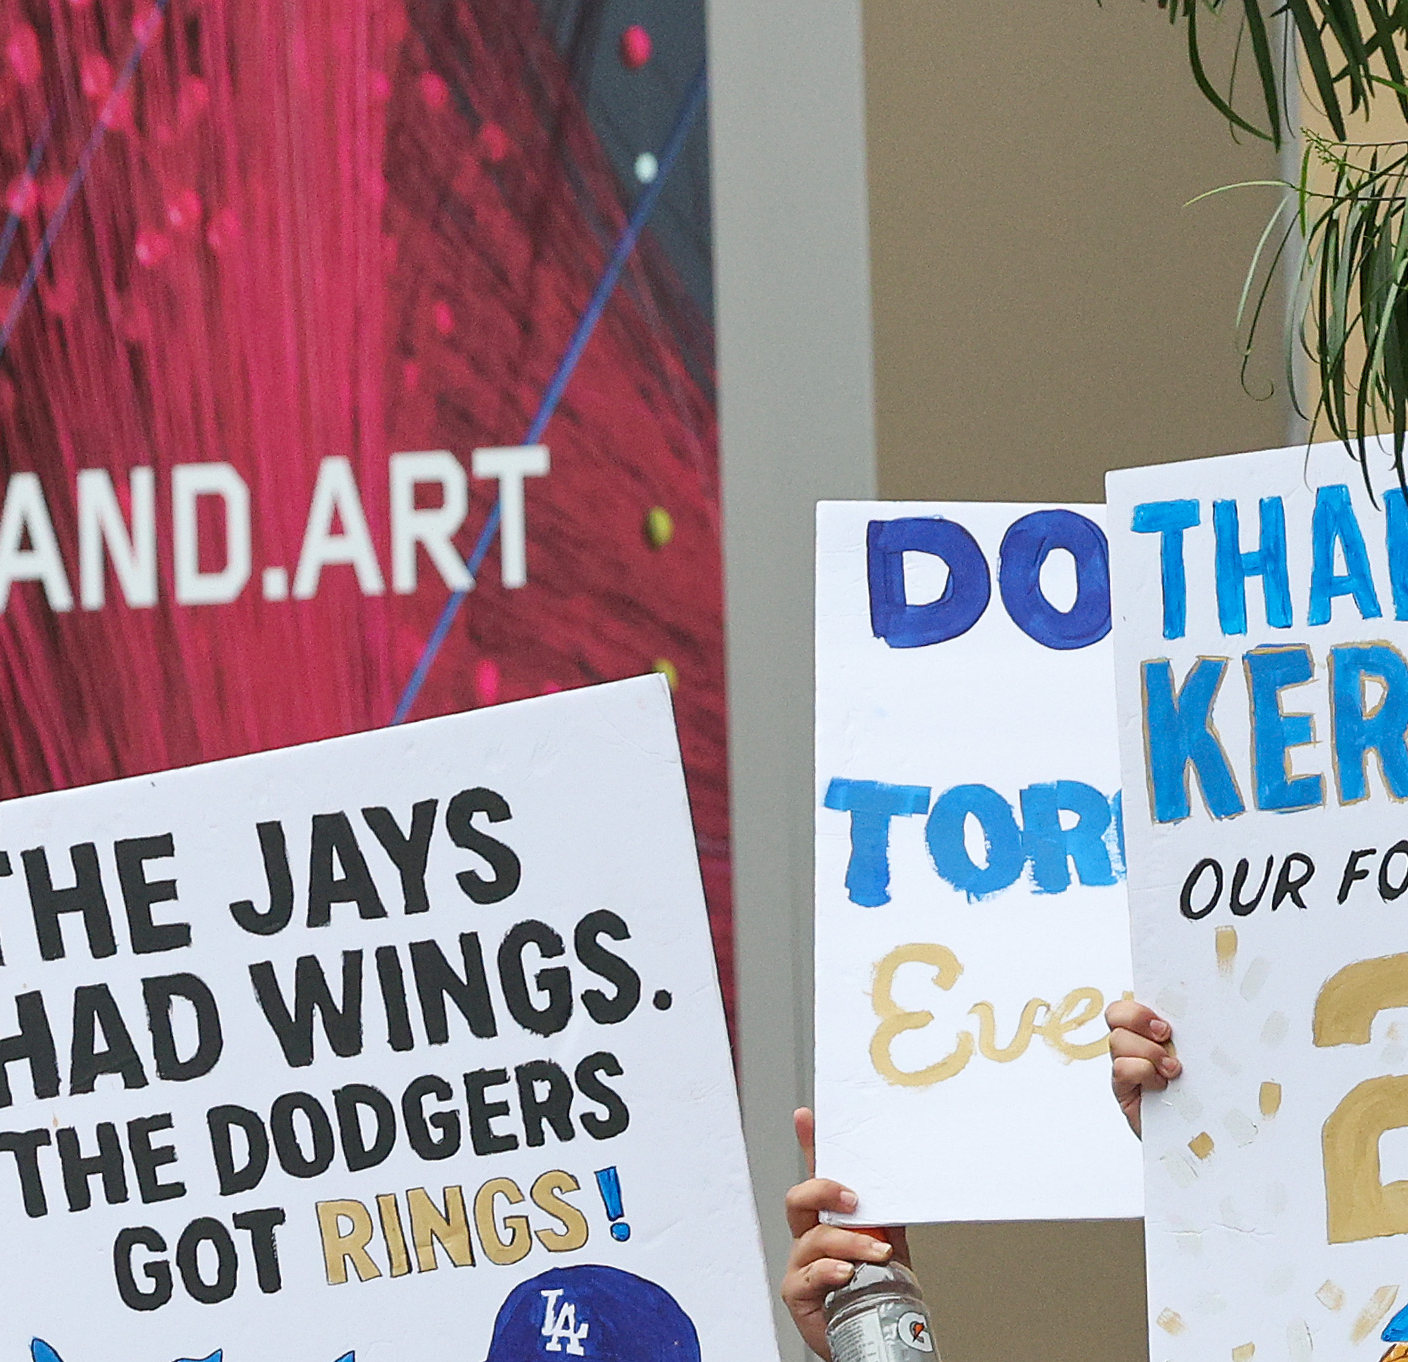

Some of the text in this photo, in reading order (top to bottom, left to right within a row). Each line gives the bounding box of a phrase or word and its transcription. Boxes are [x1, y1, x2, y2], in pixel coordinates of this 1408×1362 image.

[229, 787, 521, 936] JAYS
[824, 778, 1122, 908] TOR
[1179, 850, 1315, 920] OUR
[248, 908, 673, 1068] WINGS.
[868, 942, 1134, 1087] Eve
[206, 1051, 631, 1197] DODGERS
[113, 1165, 633, 1311] GOT RINGS!
[540, 1288, 588, 1357] LA
